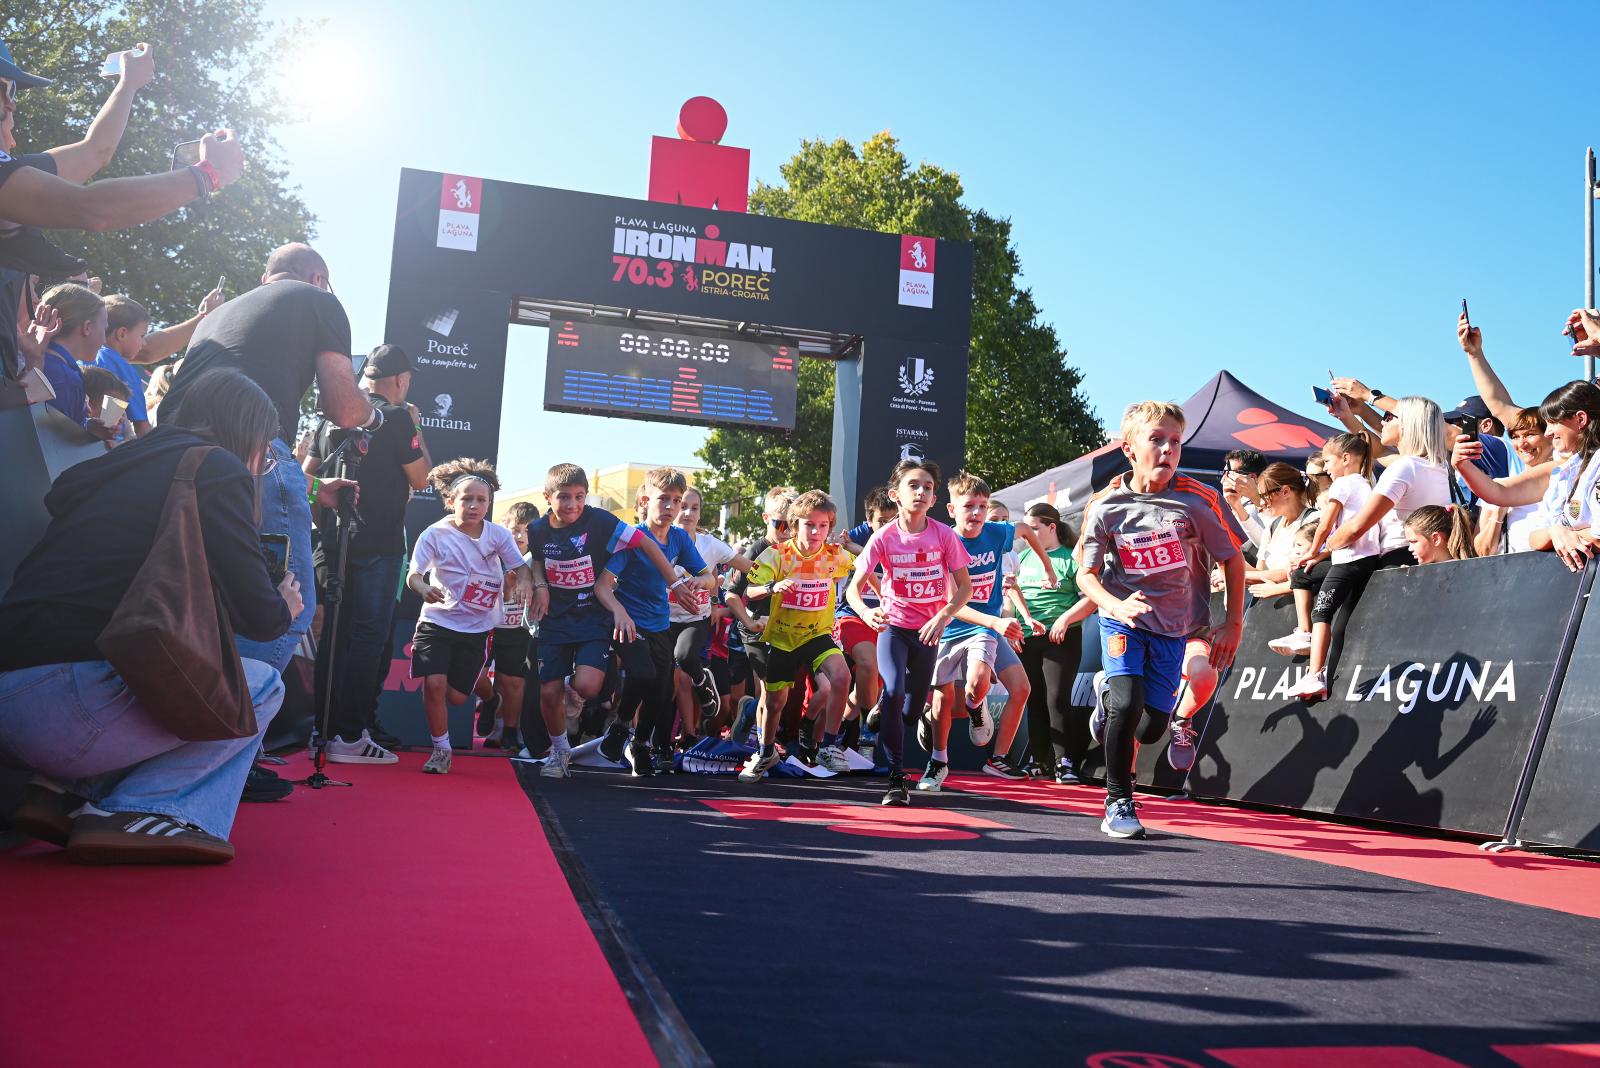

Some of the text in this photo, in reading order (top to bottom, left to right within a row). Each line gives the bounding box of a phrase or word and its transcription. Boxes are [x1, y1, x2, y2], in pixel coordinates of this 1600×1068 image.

[442, 229, 473, 237] LAGUNA
[446, 222, 470, 230] PLAVA
[615, 216, 697, 234] PLAVA LAGUNA
[613, 224, 774, 273] IRONMAN
[612, 256, 675, 288] 70.3
[702, 270, 771, 292] POREČ
[902, 287, 930, 296] LAGUNA
[427, 339, 469, 356] Poreč
[619, 332, 730, 363] 00:00:00
[417, 356, 430, 364] You
[432, 359, 467, 368] complete
[418, 412, 472, 431] untana
[1133, 531, 1172, 544] IRONKIDS
[967, 550, 996, 568] OKA
[1131, 546, 1171, 569] 218
[555, 571, 587, 585] 243
[904, 581, 936, 598] 194
[973, 585, 990, 600] 41
[795, 592, 820, 607] 191
[1346, 659, 1516, 714] LAGUNA
[688, 750, 707, 758] LAVA
